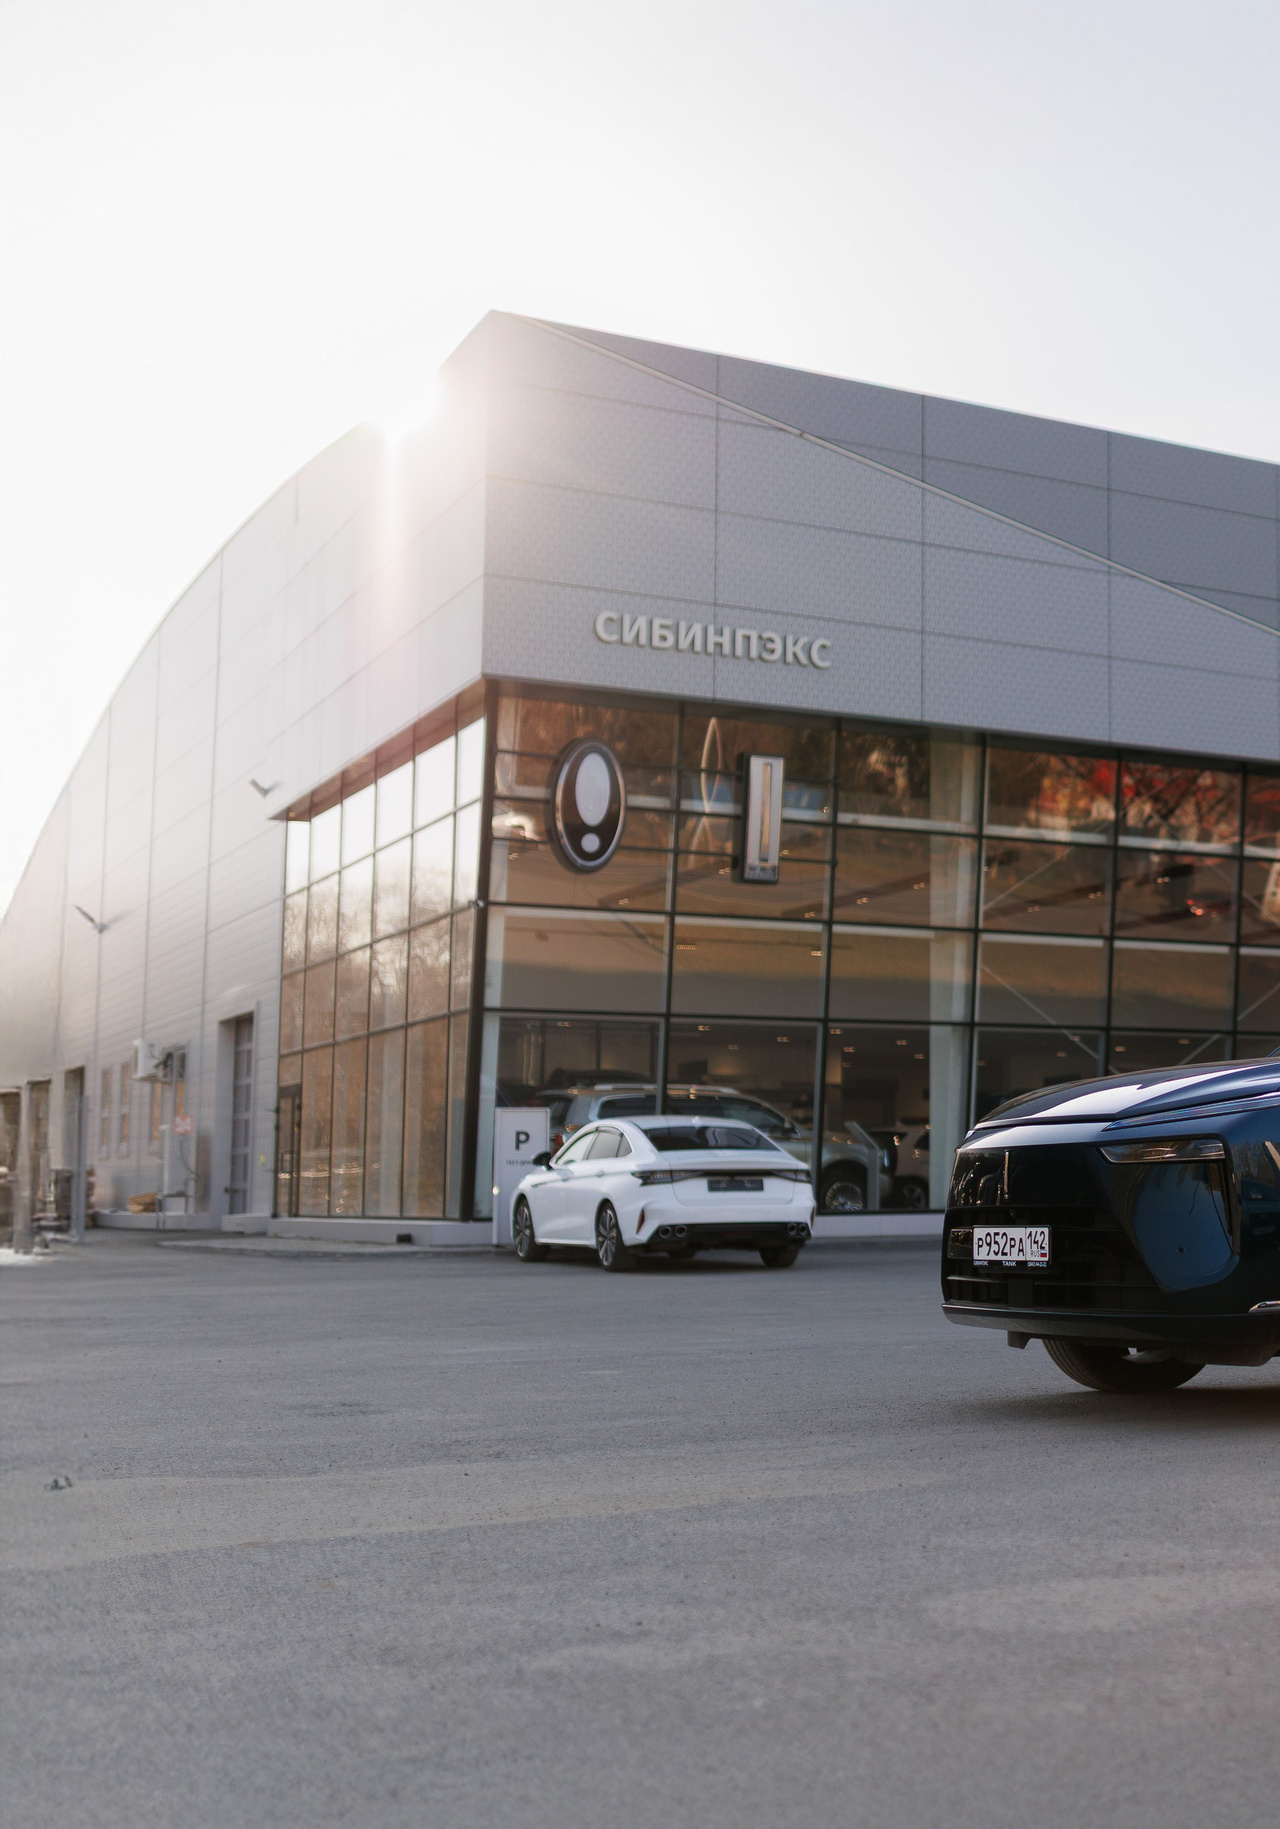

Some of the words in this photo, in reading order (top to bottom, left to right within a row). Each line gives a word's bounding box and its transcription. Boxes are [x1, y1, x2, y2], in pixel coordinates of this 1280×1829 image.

[594, 610, 831, 669] СИБИНПЭКС
[515, 1131, 530, 1150] P
[1027, 1230, 1045, 1250] 142
